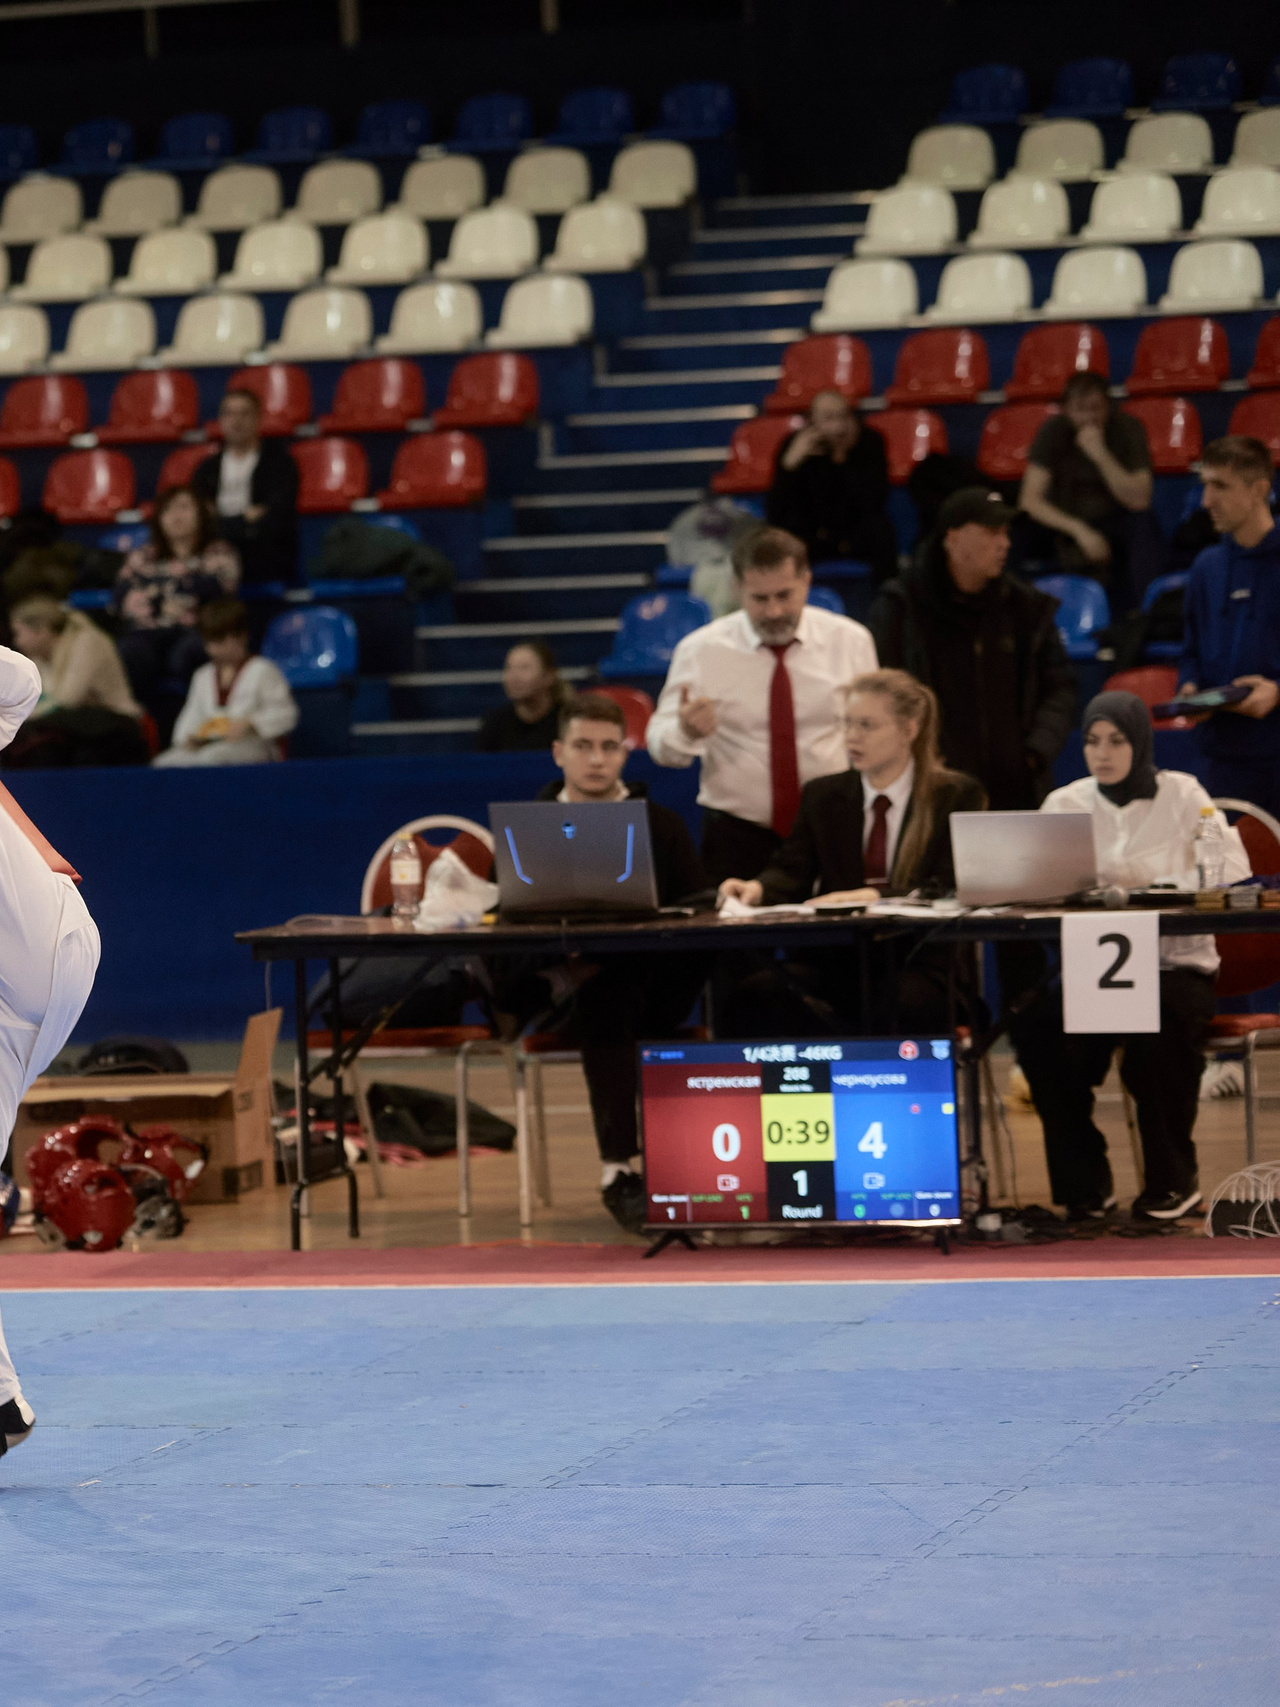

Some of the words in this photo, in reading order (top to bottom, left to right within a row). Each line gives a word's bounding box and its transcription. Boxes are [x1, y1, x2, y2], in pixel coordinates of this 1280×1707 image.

[1098, 933, 1135, 989] 2
[712, 1122, 741, 1162] 0
[767, 1120, 830, 1144] 0:39
[858, 1121, 887, 1159] 4
[792, 1170, 808, 1196] 1
[666, 1206, 676, 1220] 1
[740, 1205, 750, 1220] 1
[782, 1204, 823, 1219] Round
